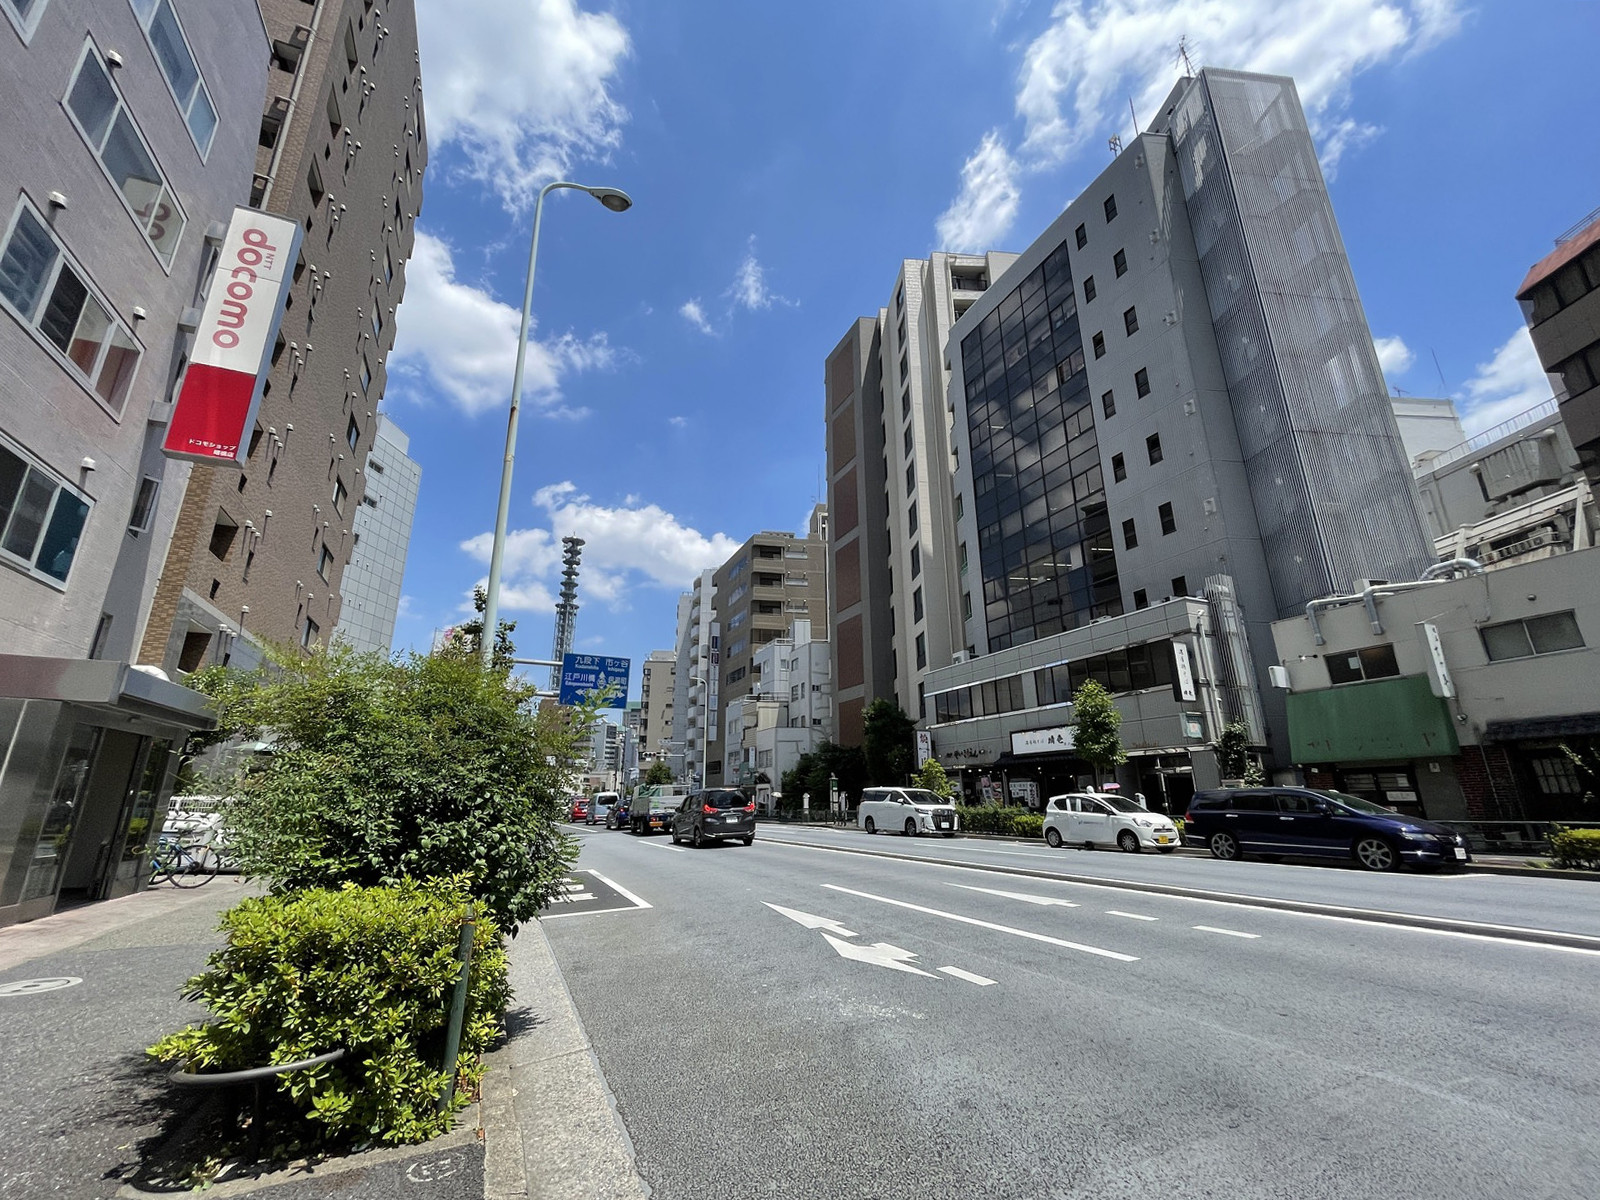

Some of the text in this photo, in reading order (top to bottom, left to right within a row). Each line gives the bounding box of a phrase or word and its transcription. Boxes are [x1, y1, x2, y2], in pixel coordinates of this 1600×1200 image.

[264, 252, 276, 271] NTT
[212, 228, 277, 348] docomo
[189, 438, 237, 451] ドコモショップ
[575, 656, 600, 665] 九段下
